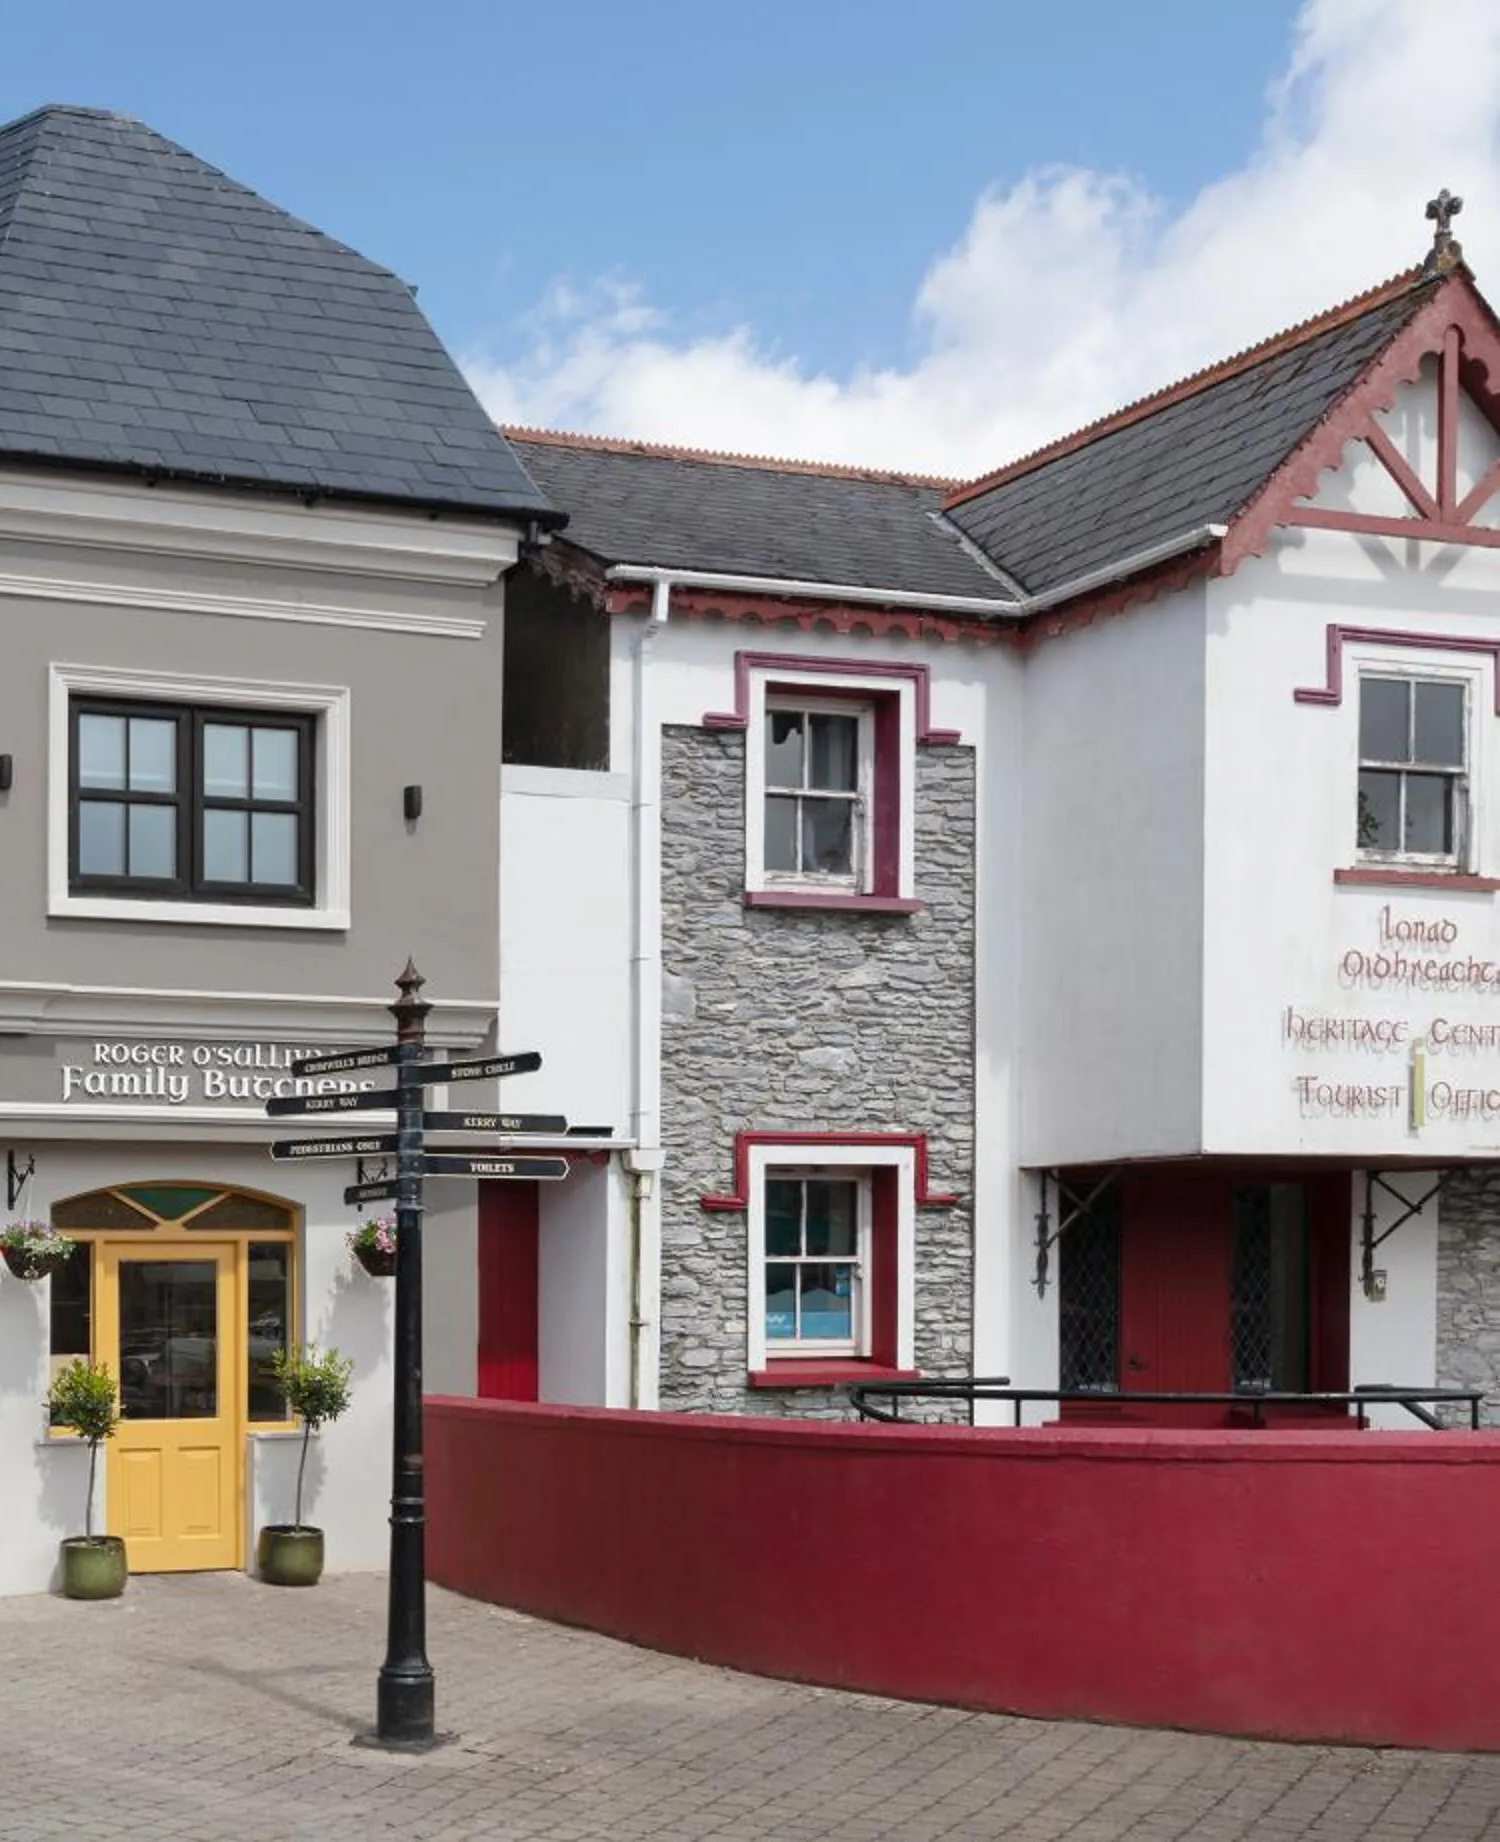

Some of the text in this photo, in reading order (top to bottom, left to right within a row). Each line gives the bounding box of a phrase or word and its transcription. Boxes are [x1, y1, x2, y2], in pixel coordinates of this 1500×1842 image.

[93, 1043, 185, 1066] ROGER
[61, 1065, 189, 1102] Family
[463, 1117, 497, 1128] KERRY
[469, 1162, 515, 1173] TOILETS
